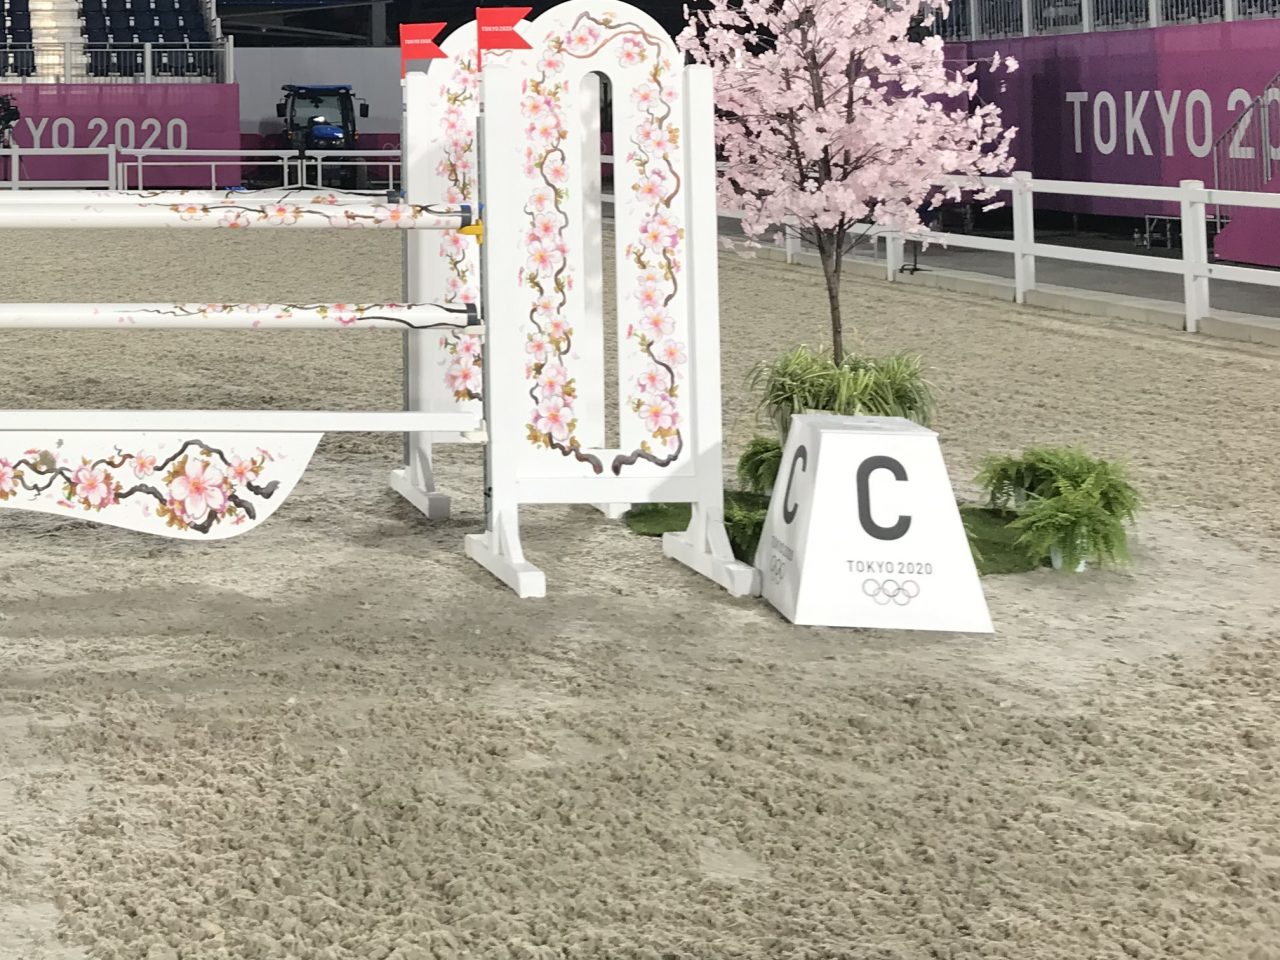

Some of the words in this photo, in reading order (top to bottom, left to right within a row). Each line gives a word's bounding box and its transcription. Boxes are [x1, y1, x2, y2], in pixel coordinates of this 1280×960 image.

[87, 117, 188, 152] 2020
[1065, 89, 1213, 158] TOKYO
[783, 444, 808, 525] C
[856, 455, 912, 541] C
[846, 560, 894, 574] TOKYO
[897, 561, 933, 575] 2020
